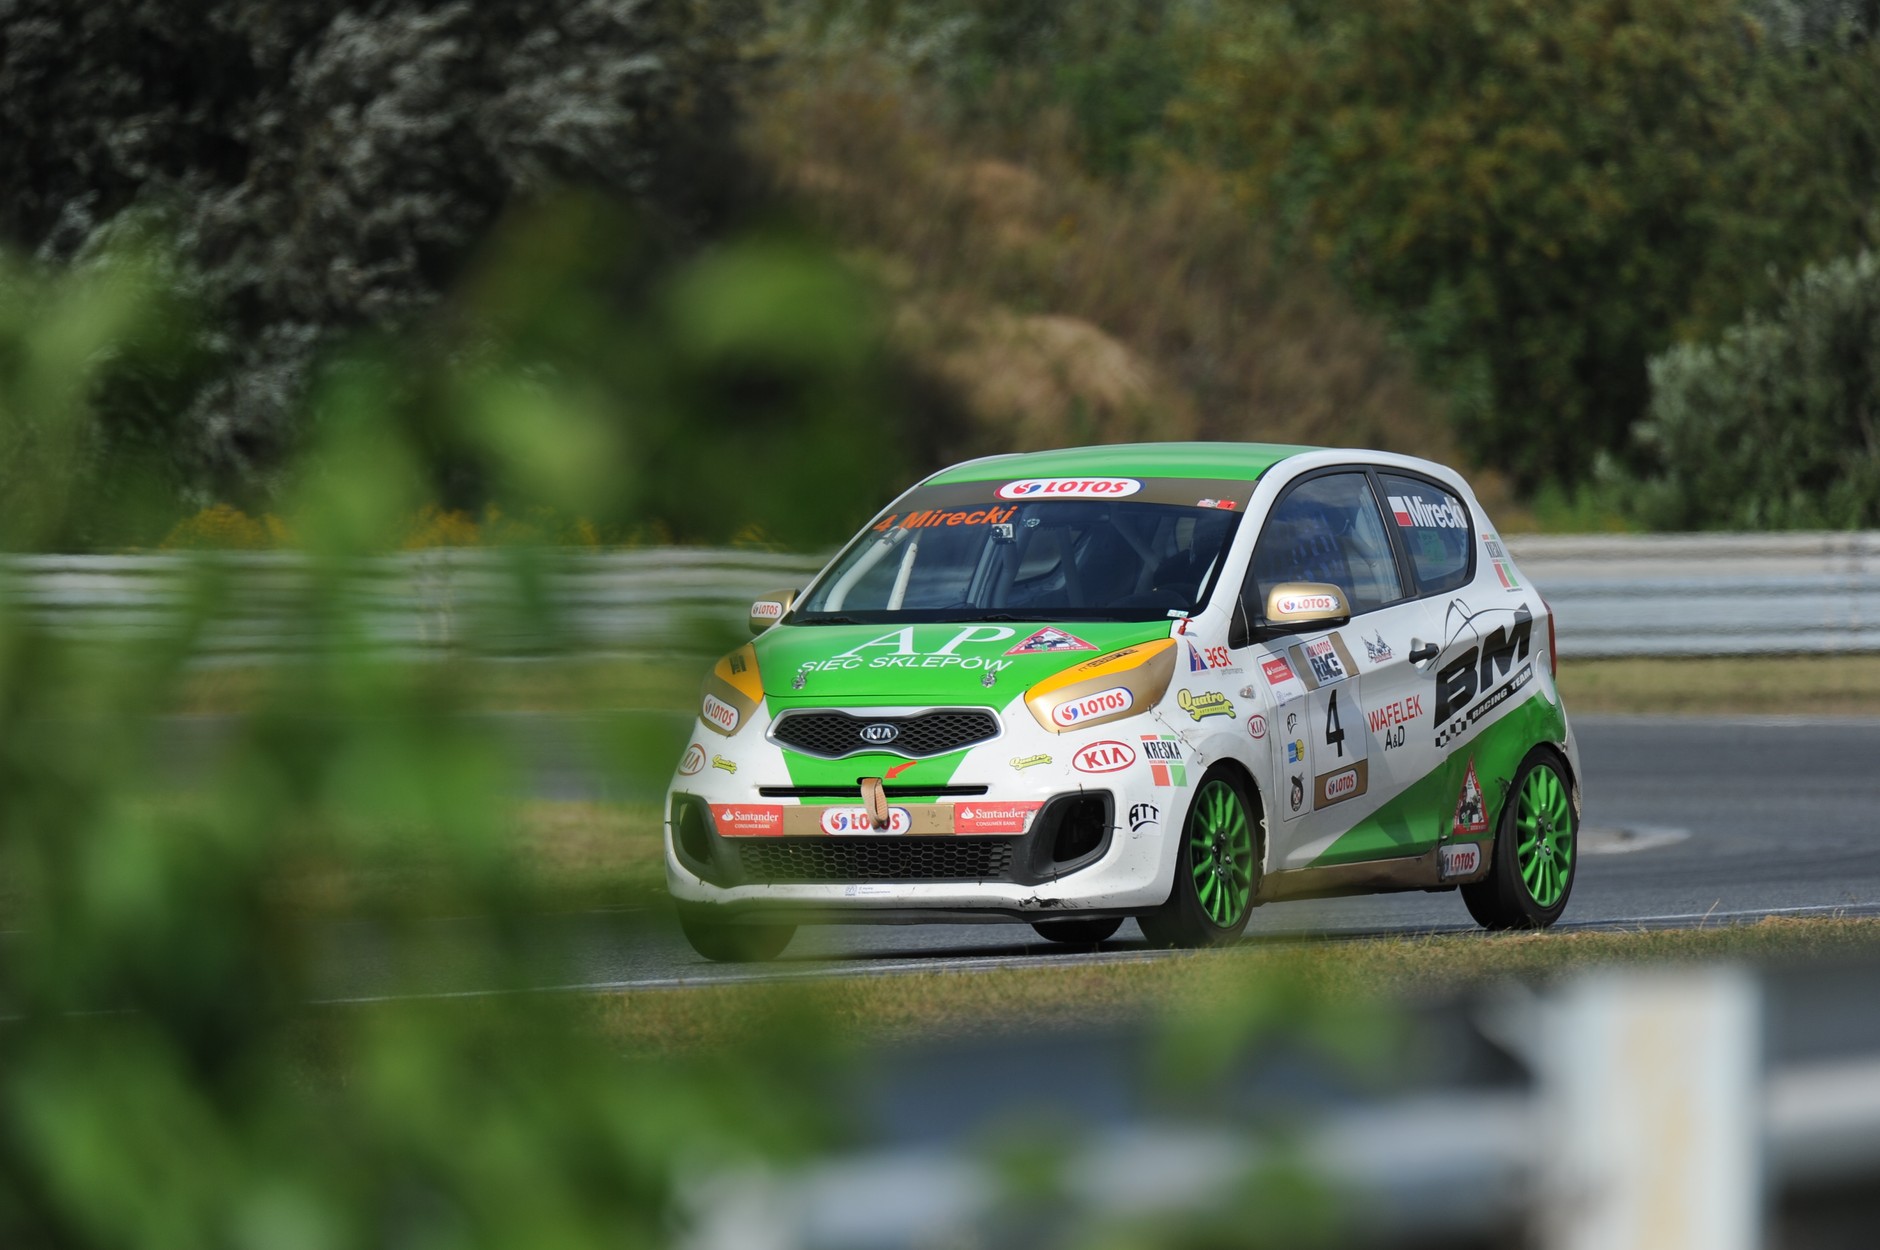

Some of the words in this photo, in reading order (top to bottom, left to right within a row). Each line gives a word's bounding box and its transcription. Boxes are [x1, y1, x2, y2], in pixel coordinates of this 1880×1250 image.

[1042, 481, 1128, 493] LOTOS
[873, 514, 899, 532] 4
[897, 506, 1018, 529] Mirecki
[1403, 496, 1468, 528] Mirecki
[758, 604, 779, 616] LOTOS
[1297, 598, 1331, 610] LOTOS
[832, 626, 1016, 659] AP
[799, 654, 867, 672] SIEĆ
[868, 655, 1014, 673] SKLEPÓW
[1310, 652, 1343, 682] RACE
[1434, 602, 1533, 729] BM
[1080, 692, 1125, 716] LOTOS
[1177, 688, 1225, 712] Quatro
[1471, 687, 1508, 720] RACING
[1510, 667, 1533, 691] TEAM
[710, 702, 734, 726] LOTOS
[1326, 689, 1345, 757] 4
[1368, 695, 1423, 732] WAFELEK
[866, 727, 892, 740] KIA
[1250, 718, 1265, 735] KIA
[682, 750, 700, 772] KIA
[1083, 748, 1129, 769] KIA
[1143, 742, 1182, 759] KRESKA
[1335, 774, 1354, 792] LOTOS
[735, 811, 779, 822] Santander
[851, 812, 900, 831] LOOS
[975, 808, 1025, 819] Santander
[1450, 852, 1475, 871] LOTOS
